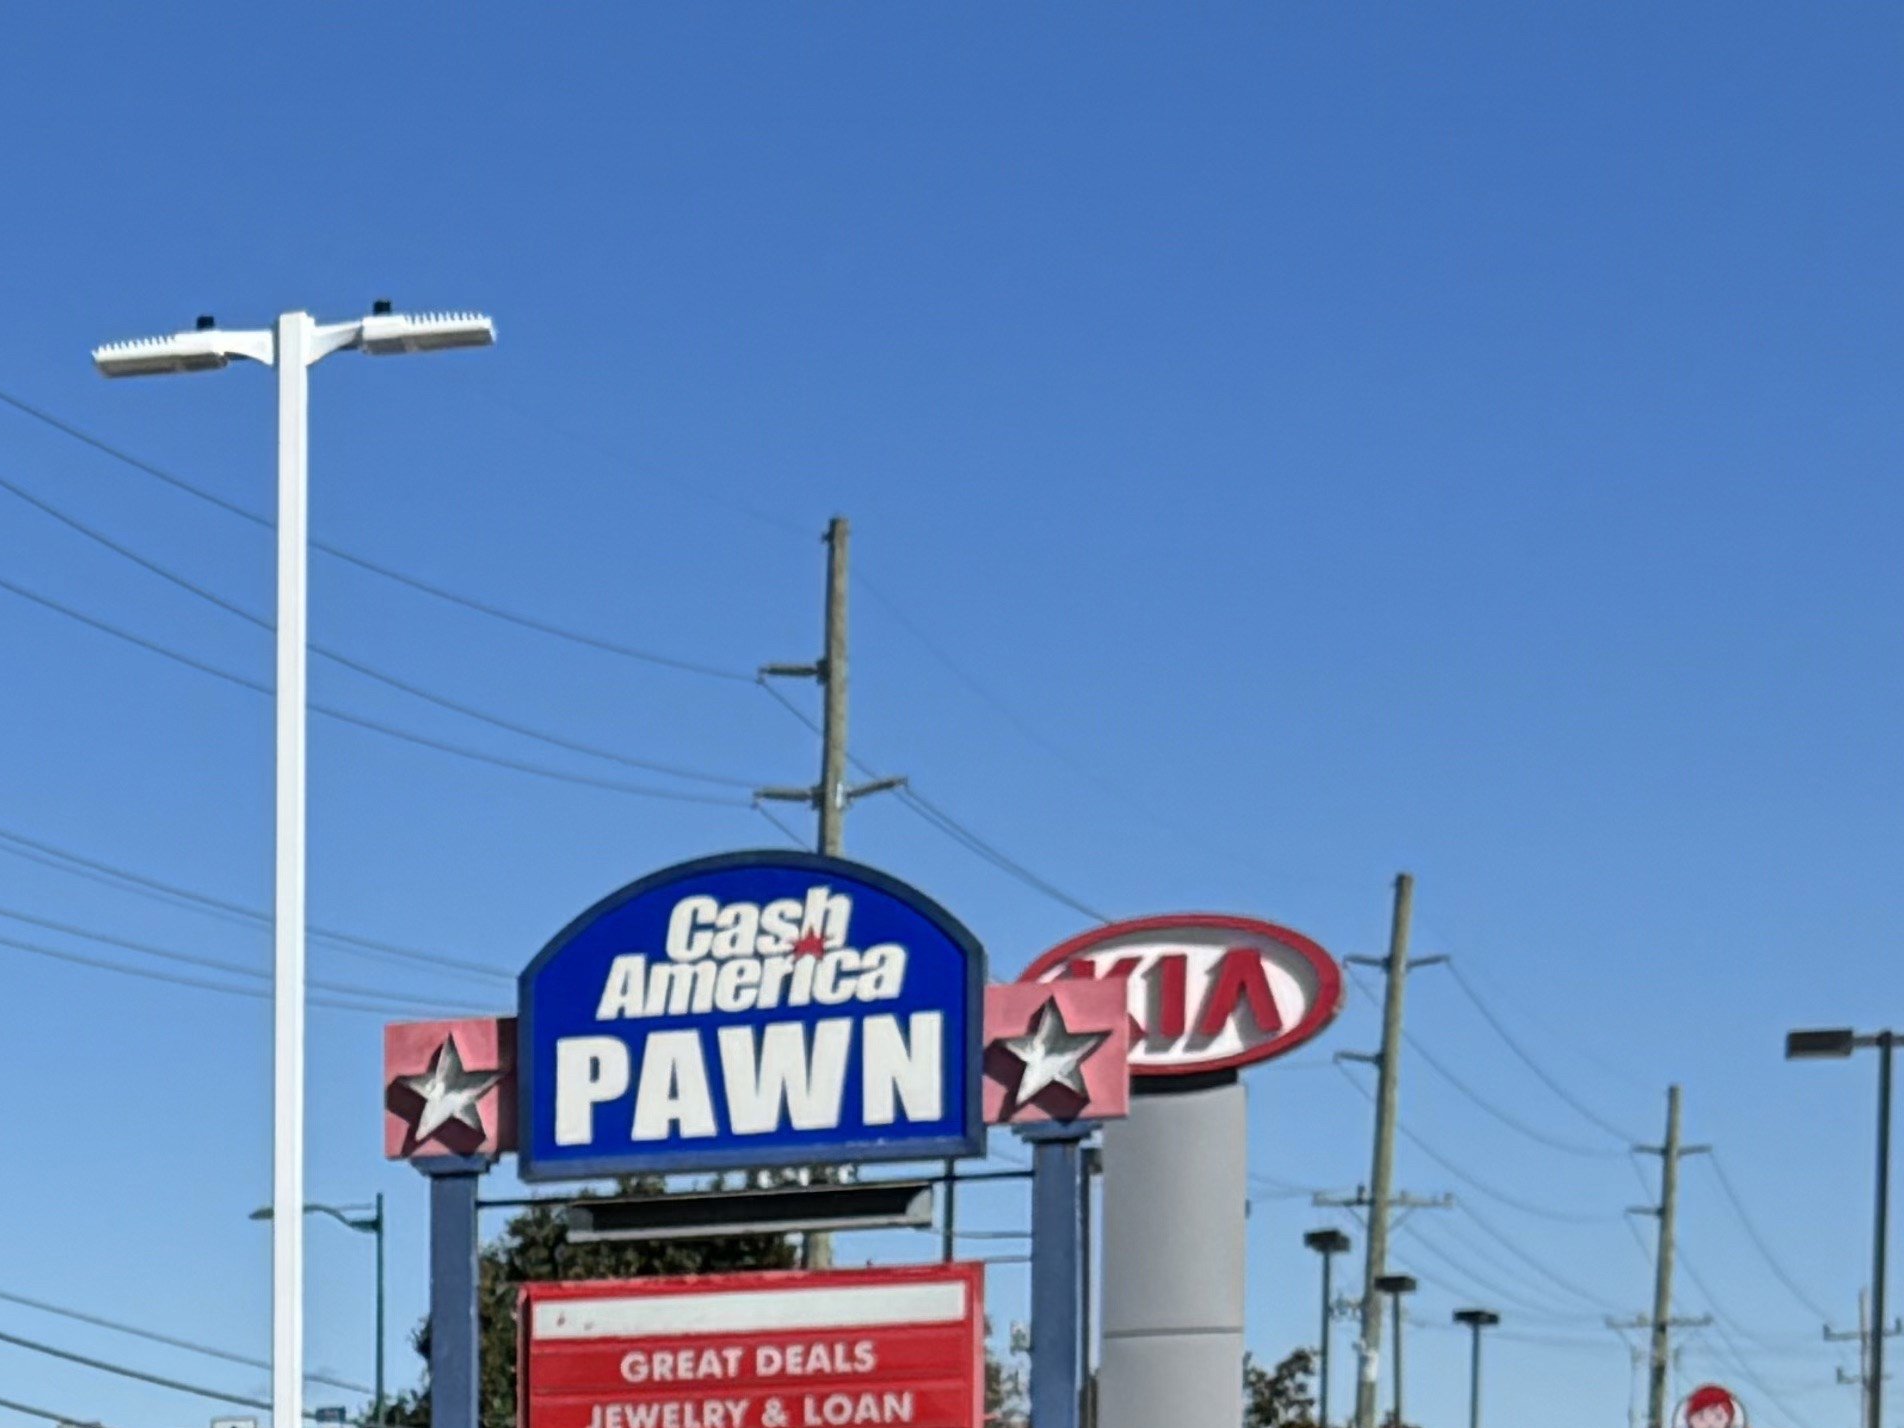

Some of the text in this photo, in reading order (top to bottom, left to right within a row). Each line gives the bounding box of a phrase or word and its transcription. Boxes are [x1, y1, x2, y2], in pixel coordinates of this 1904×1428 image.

[666, 885, 852, 963] Cash
[595, 944, 908, 1021] America
[1067, 946, 1284, 1038] IA
[555, 1010, 944, 1147] PAWN
[620, 1339, 877, 1383] GREAT DEALS
[803, 1390, 914, 1428] LOAN
